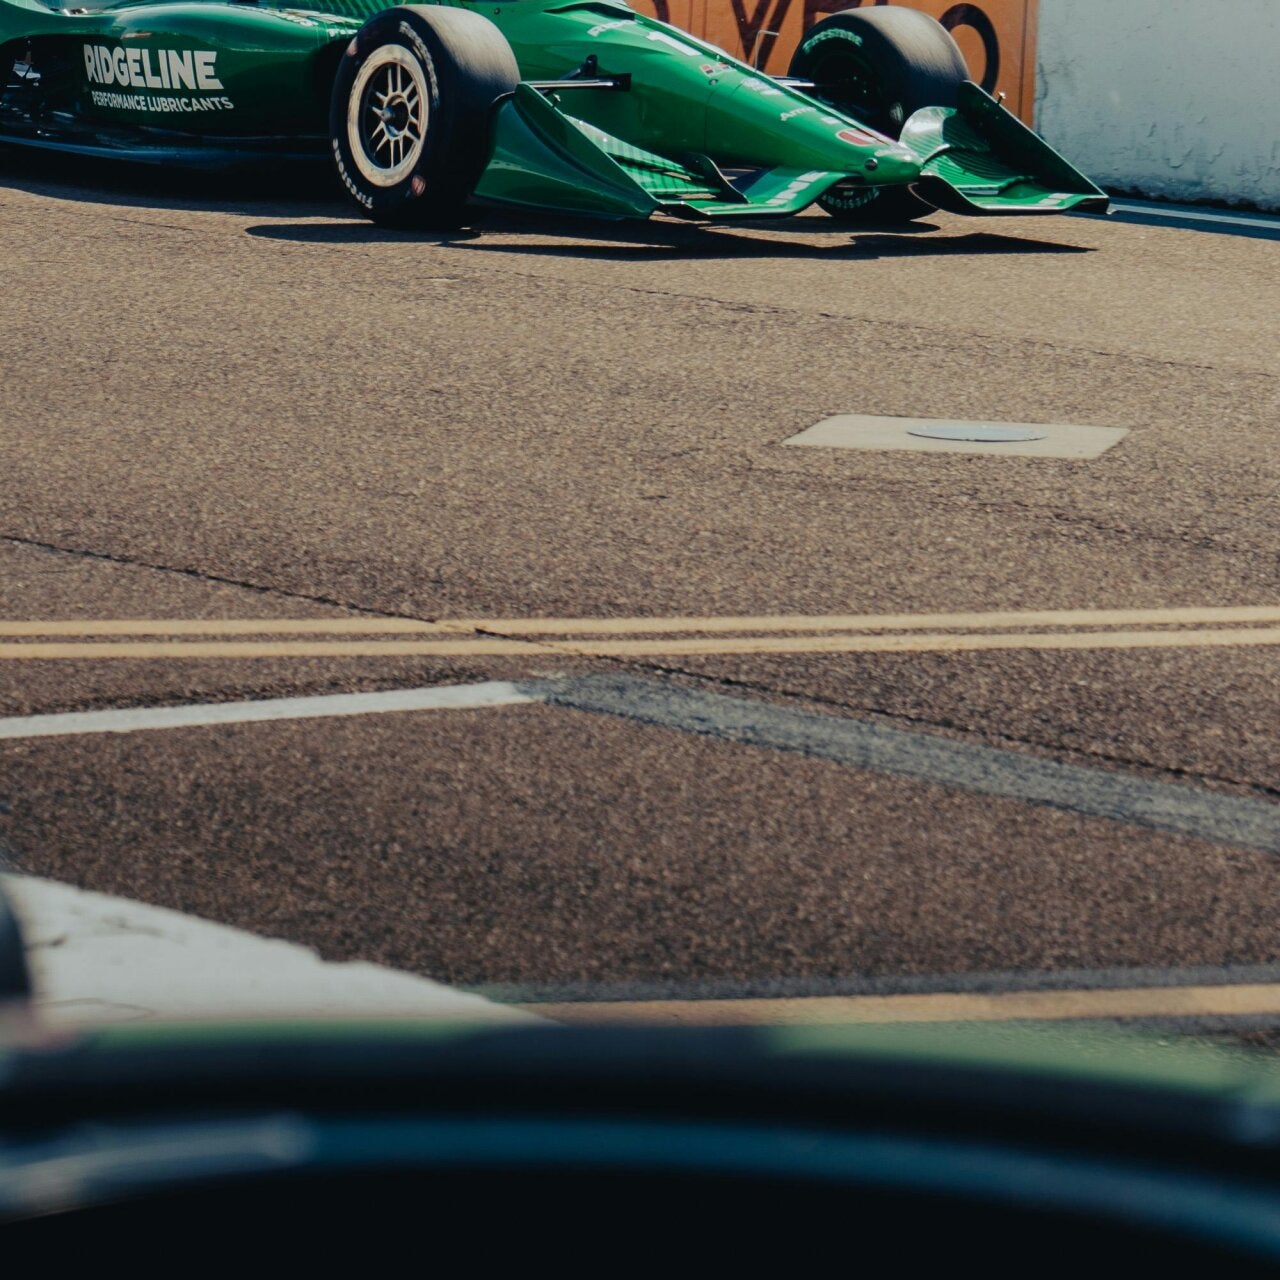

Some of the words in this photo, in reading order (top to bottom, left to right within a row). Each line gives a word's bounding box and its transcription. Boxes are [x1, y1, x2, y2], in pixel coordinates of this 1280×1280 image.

[83, 43, 224, 90] RIDGELINE
[91, 91, 147, 111] PERFORMANCE
[147, 96, 235, 112] LUBRICANTS
[332, 137, 374, 209] Firestone
